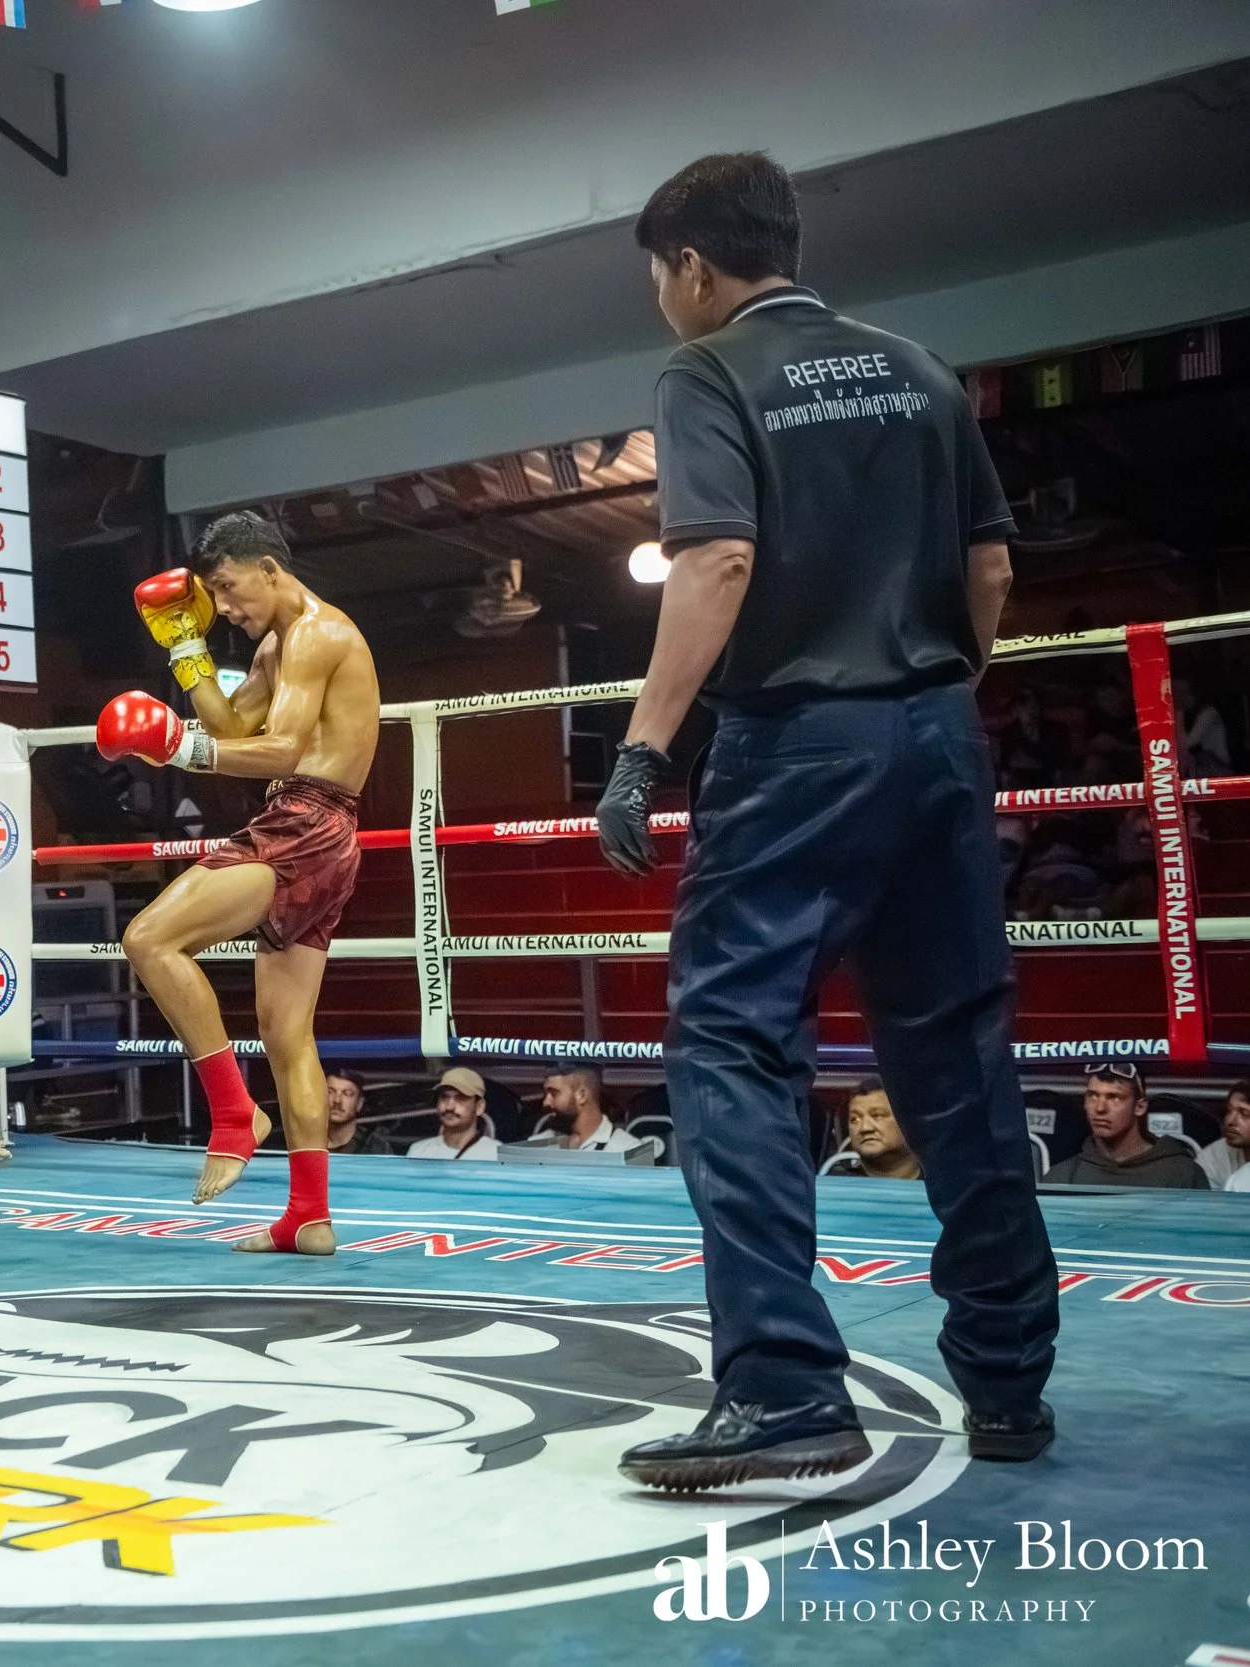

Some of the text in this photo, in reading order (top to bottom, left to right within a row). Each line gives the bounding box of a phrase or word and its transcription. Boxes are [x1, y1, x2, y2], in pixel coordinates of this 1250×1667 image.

[783, 353, 891, 387] REFEREE
[1016, 777, 1216, 806] INTERNATIAL
[493, 820, 554, 836] SAMUI
[152, 840, 201, 857] SAMUI
[1150, 739, 1196, 1020] SAMUI INTERNATIONAL
[419, 788, 443, 1016] SAMUI INTERNATIONAL
[1006, 920, 1143, 941] RNATIONAL
[442, 934, 647, 950] AMUI INTERNATIONAL
[116, 1039, 167, 1052] SAMUI
[458, 1036, 662, 1058] SAMUI INTERNATIONA
